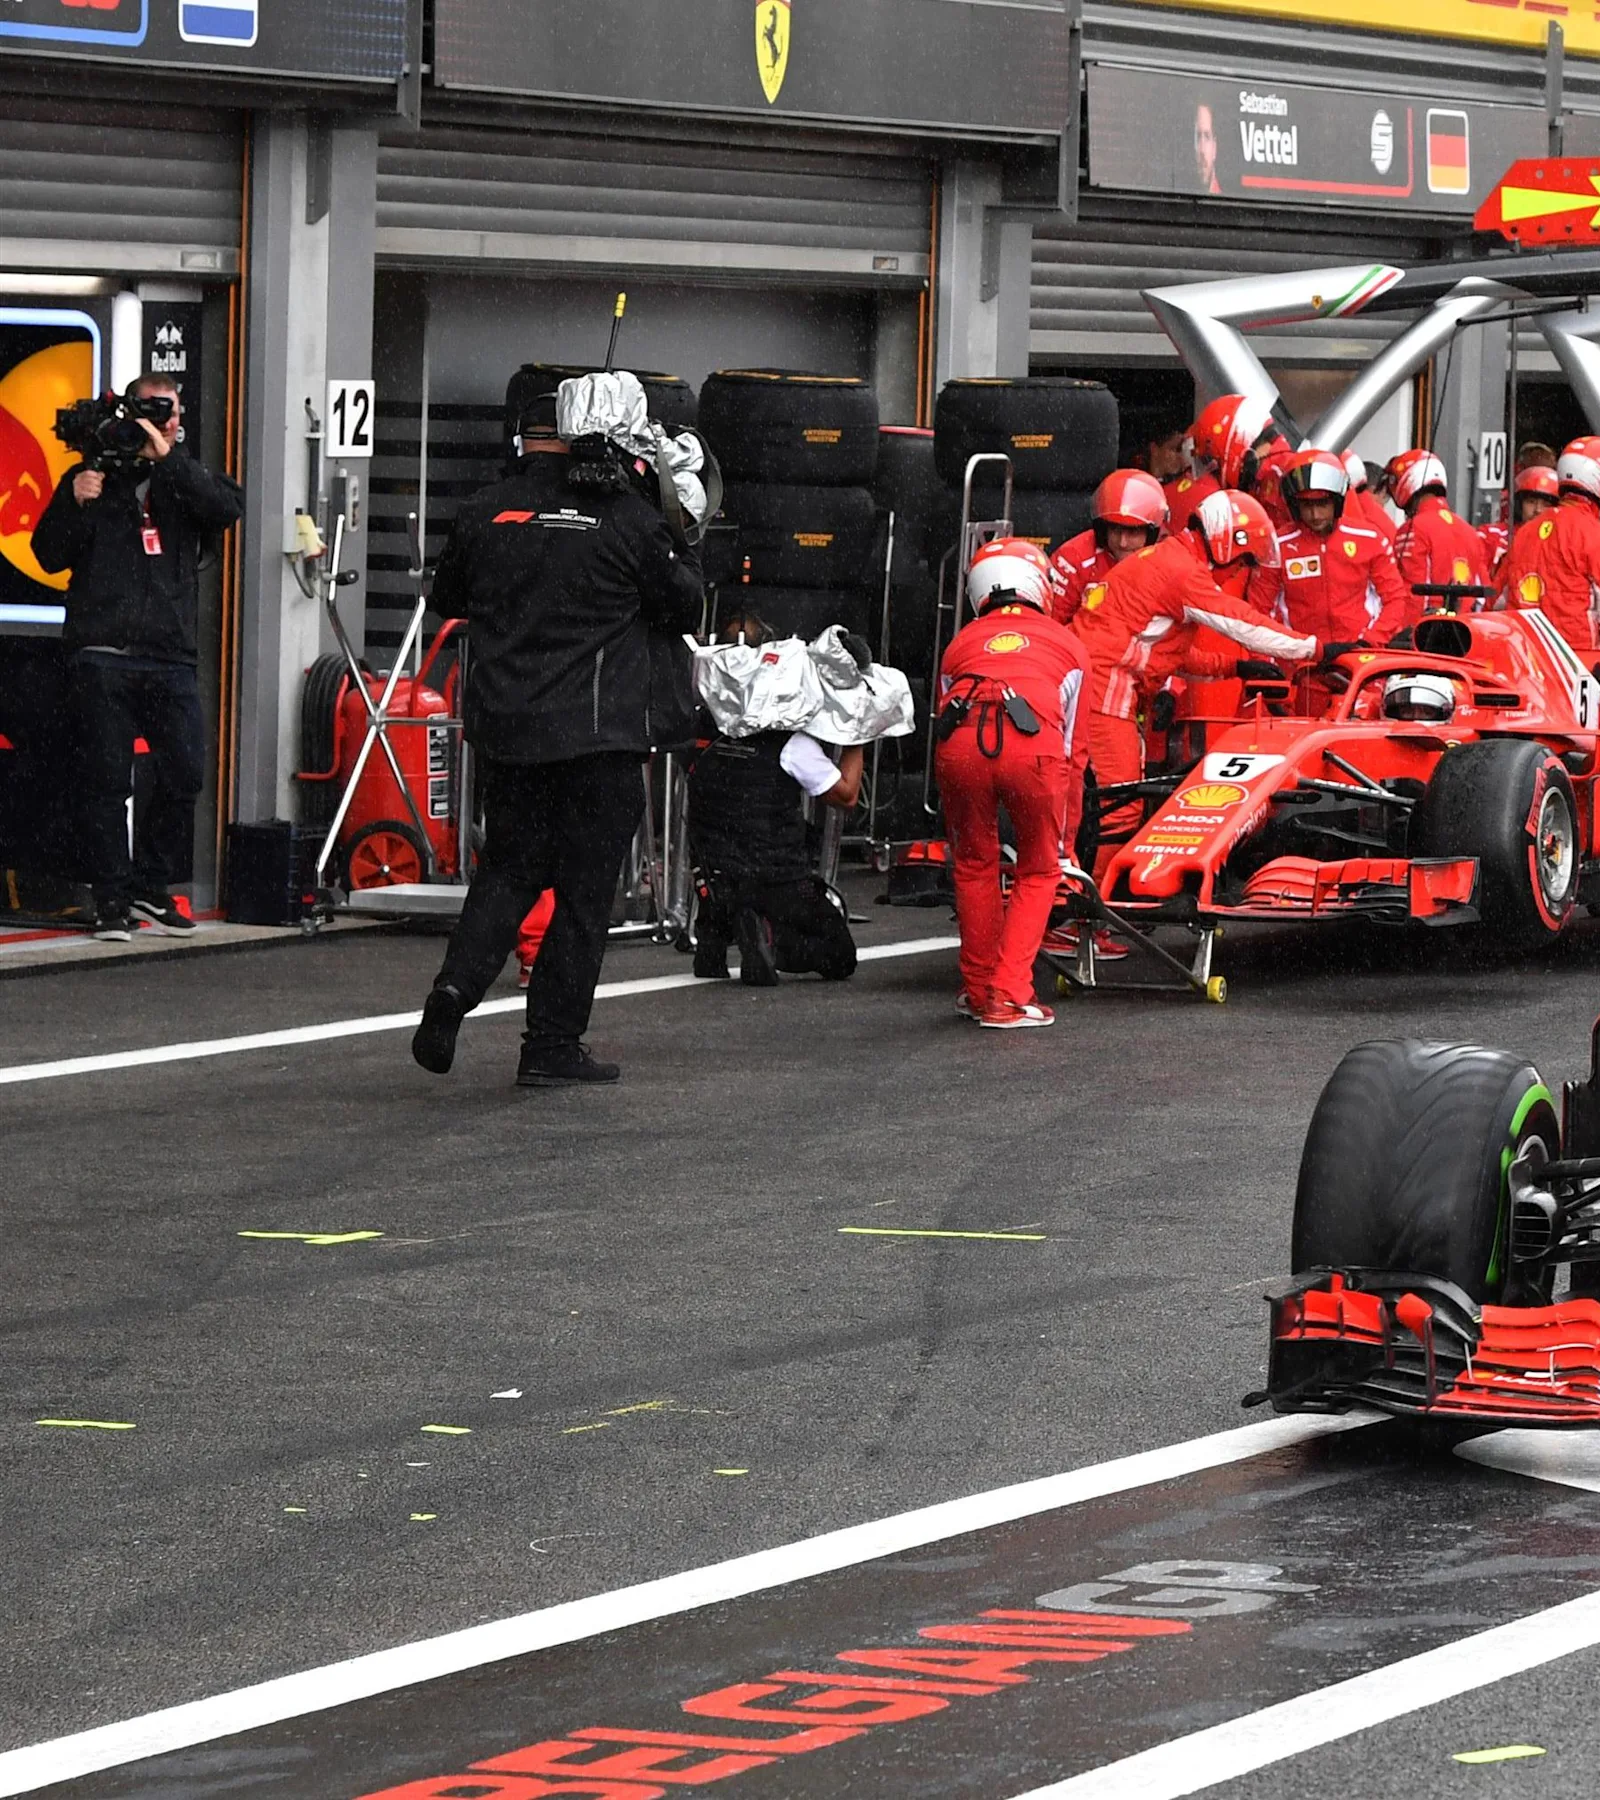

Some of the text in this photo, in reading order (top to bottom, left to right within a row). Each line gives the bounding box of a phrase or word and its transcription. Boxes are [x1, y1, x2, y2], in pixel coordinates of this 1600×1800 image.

[1239, 91, 1288, 116] Sebastian
[1240, 120, 1298, 166] Vettel
[333, 388, 370, 446] 12
[1484, 438, 1504, 481] 10
[1579, 680, 1589, 728] 5
[1218, 757, 1256, 778] 5
[1134, 845, 1199, 855] MAHLE
[1034, 1559, 1322, 1617] GP
